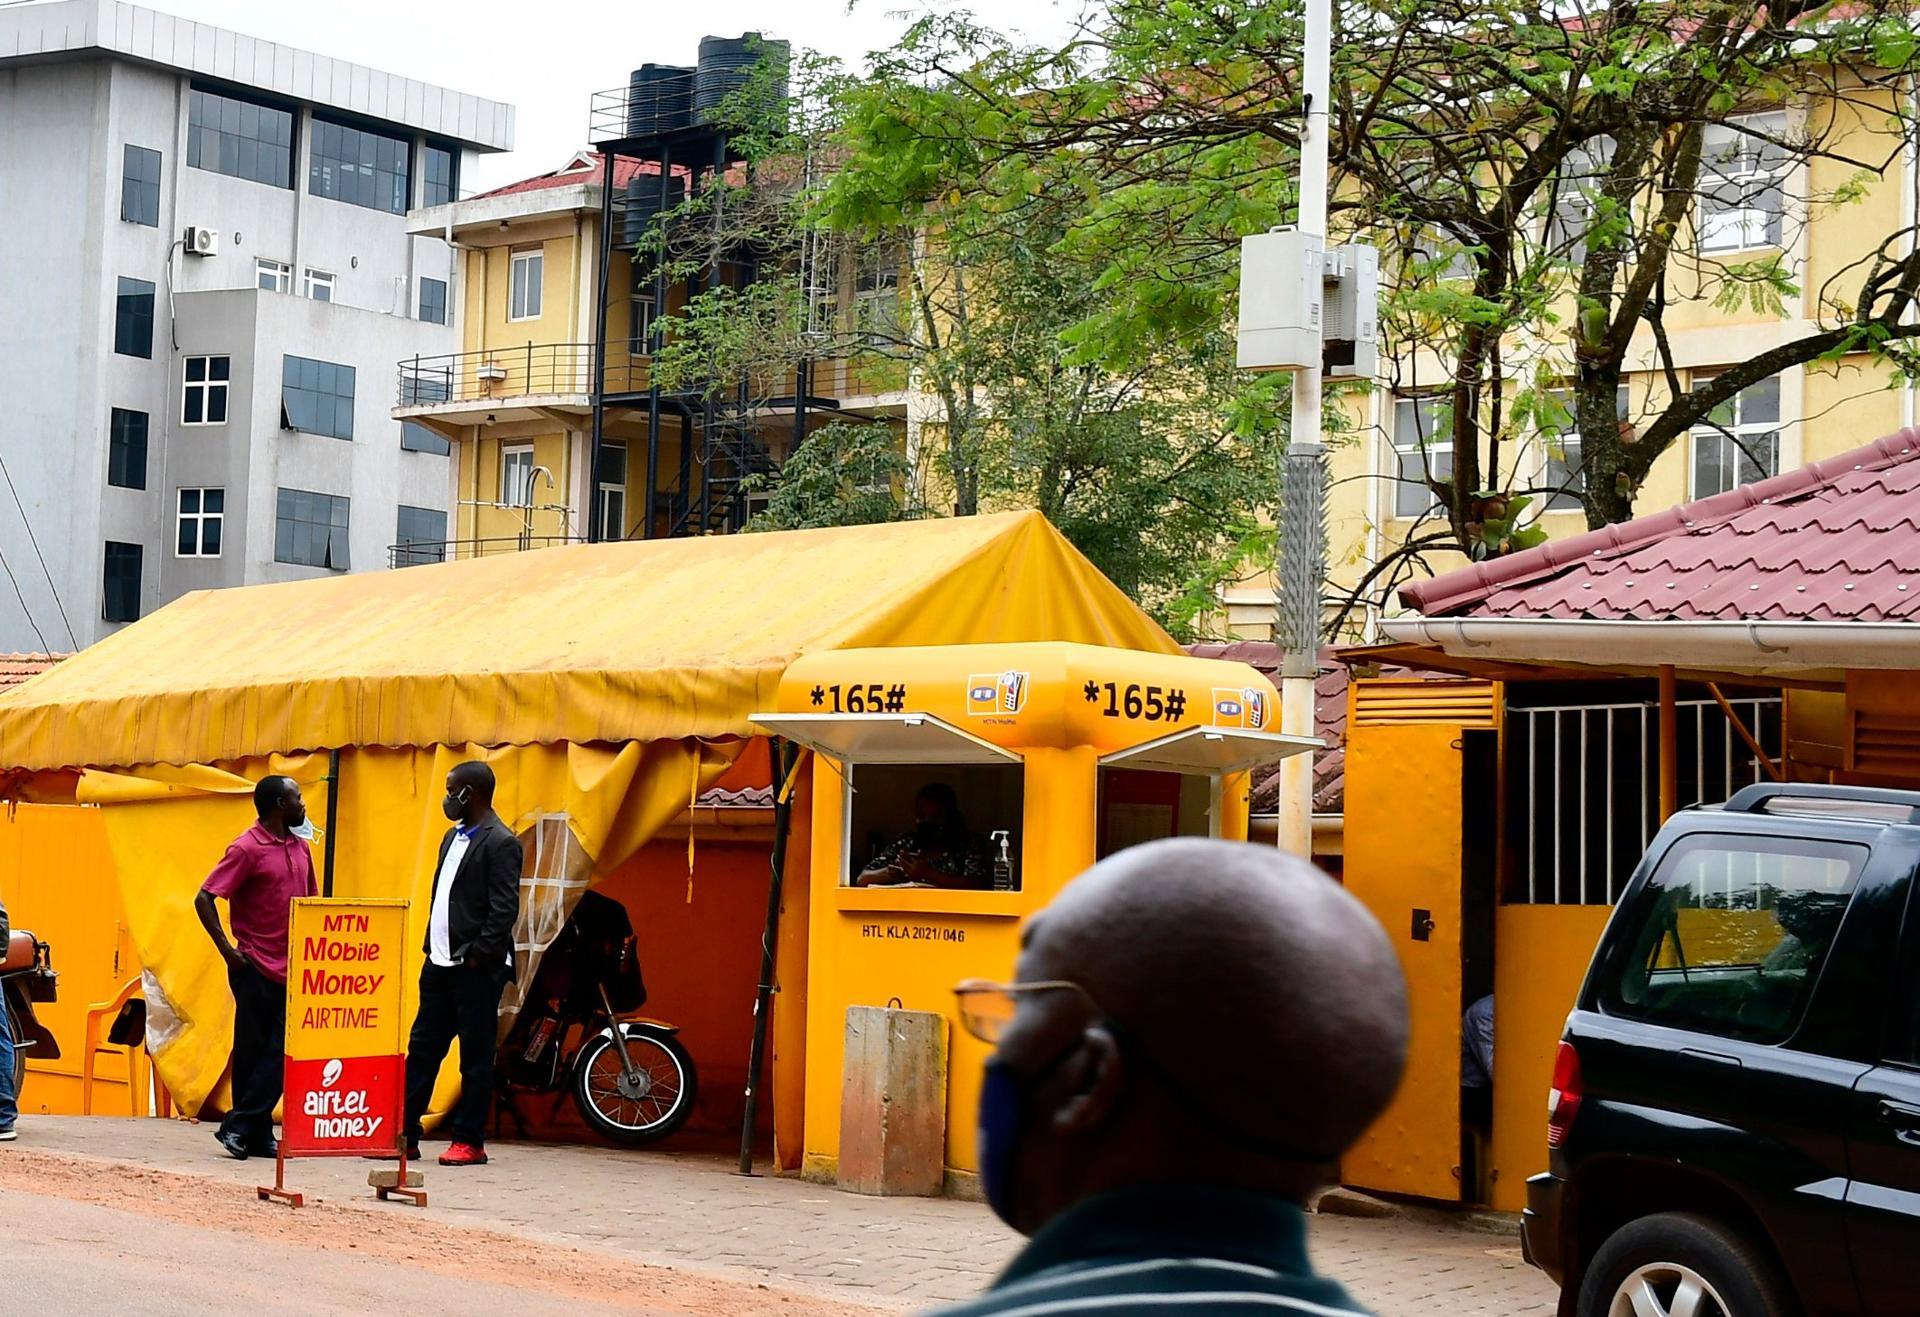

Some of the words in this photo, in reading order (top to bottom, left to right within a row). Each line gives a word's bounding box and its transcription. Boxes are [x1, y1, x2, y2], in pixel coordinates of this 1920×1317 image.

[323, 914, 369, 933] MTN
[887, 925, 910, 939] KLA
[303, 937, 380, 962] Mobile
[302, 969, 385, 996] Money
[301, 1007, 379, 1030] AIRTIME
[303, 1090, 370, 1116] airtel
[314, 1115, 384, 1139] money
